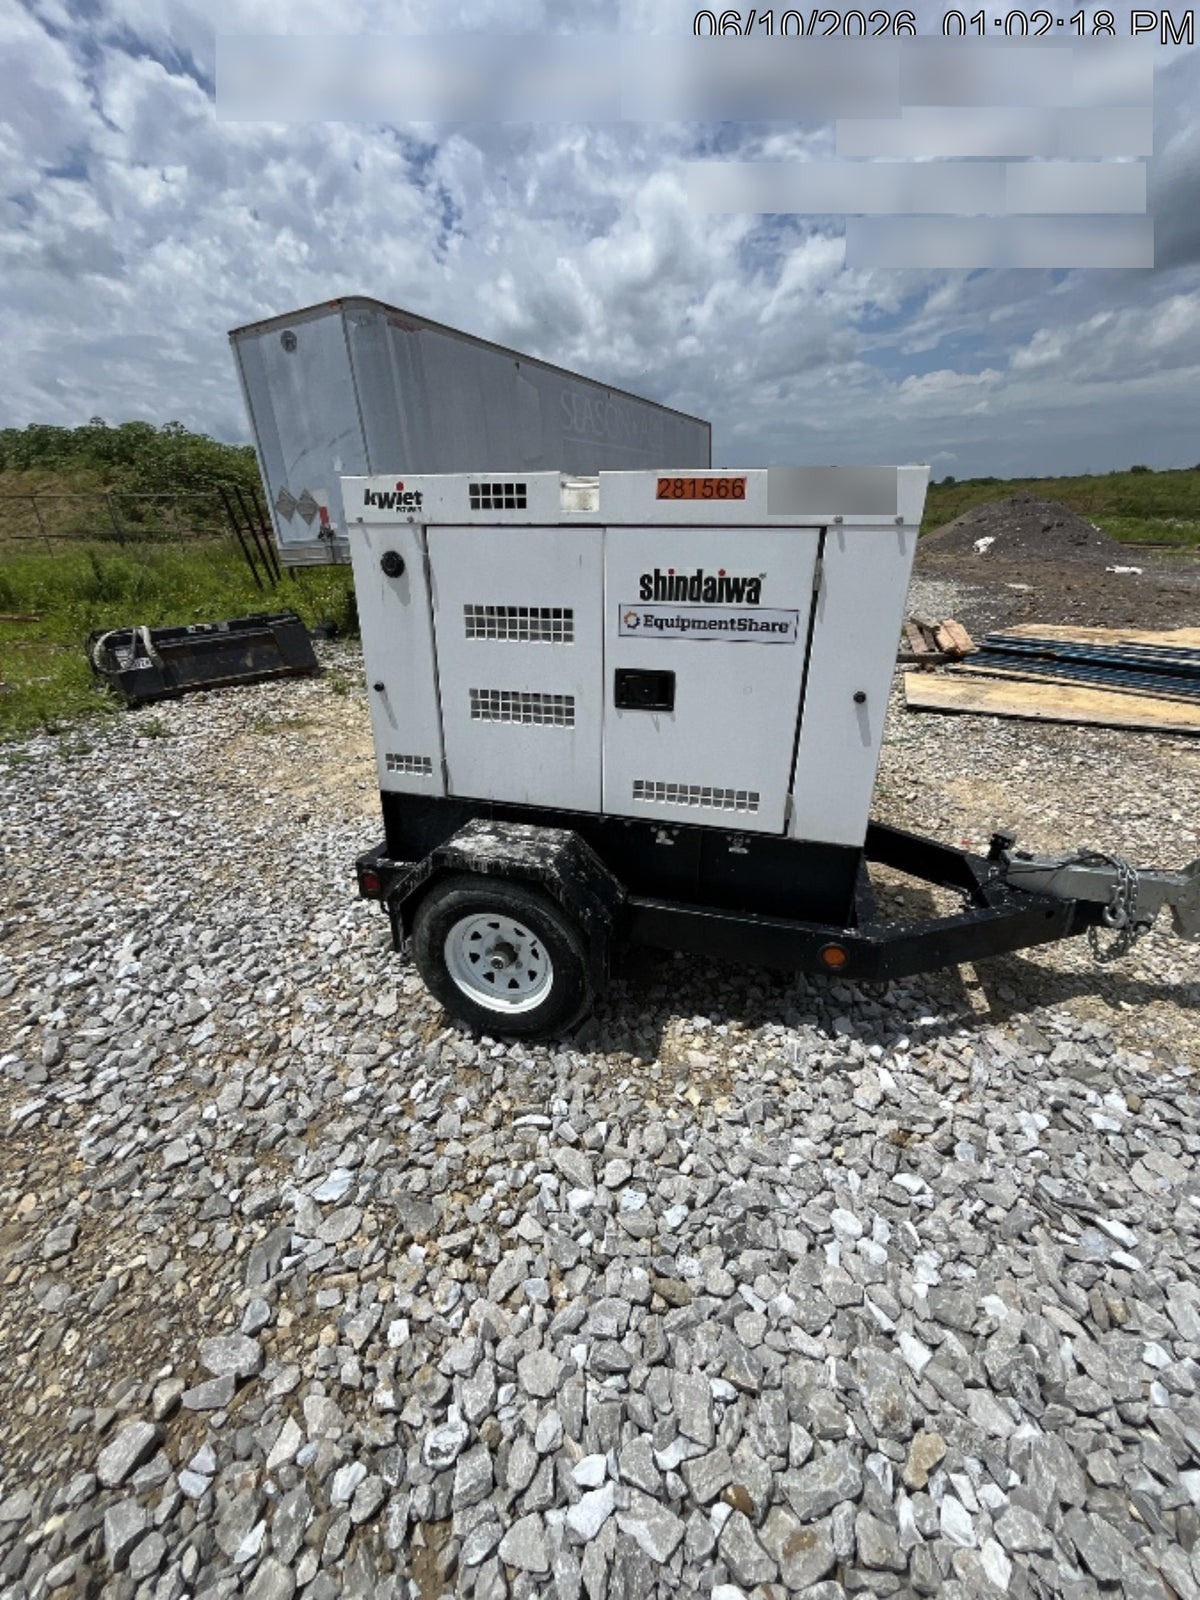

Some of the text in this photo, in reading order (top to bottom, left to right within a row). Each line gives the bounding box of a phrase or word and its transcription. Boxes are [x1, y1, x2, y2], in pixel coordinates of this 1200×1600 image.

[364, 481, 423, 509] kwiet
[658, 477, 745, 499] 281566
[639, 568, 762, 605] shindaiwa
[643, 614, 790, 634] EquipmentShare
